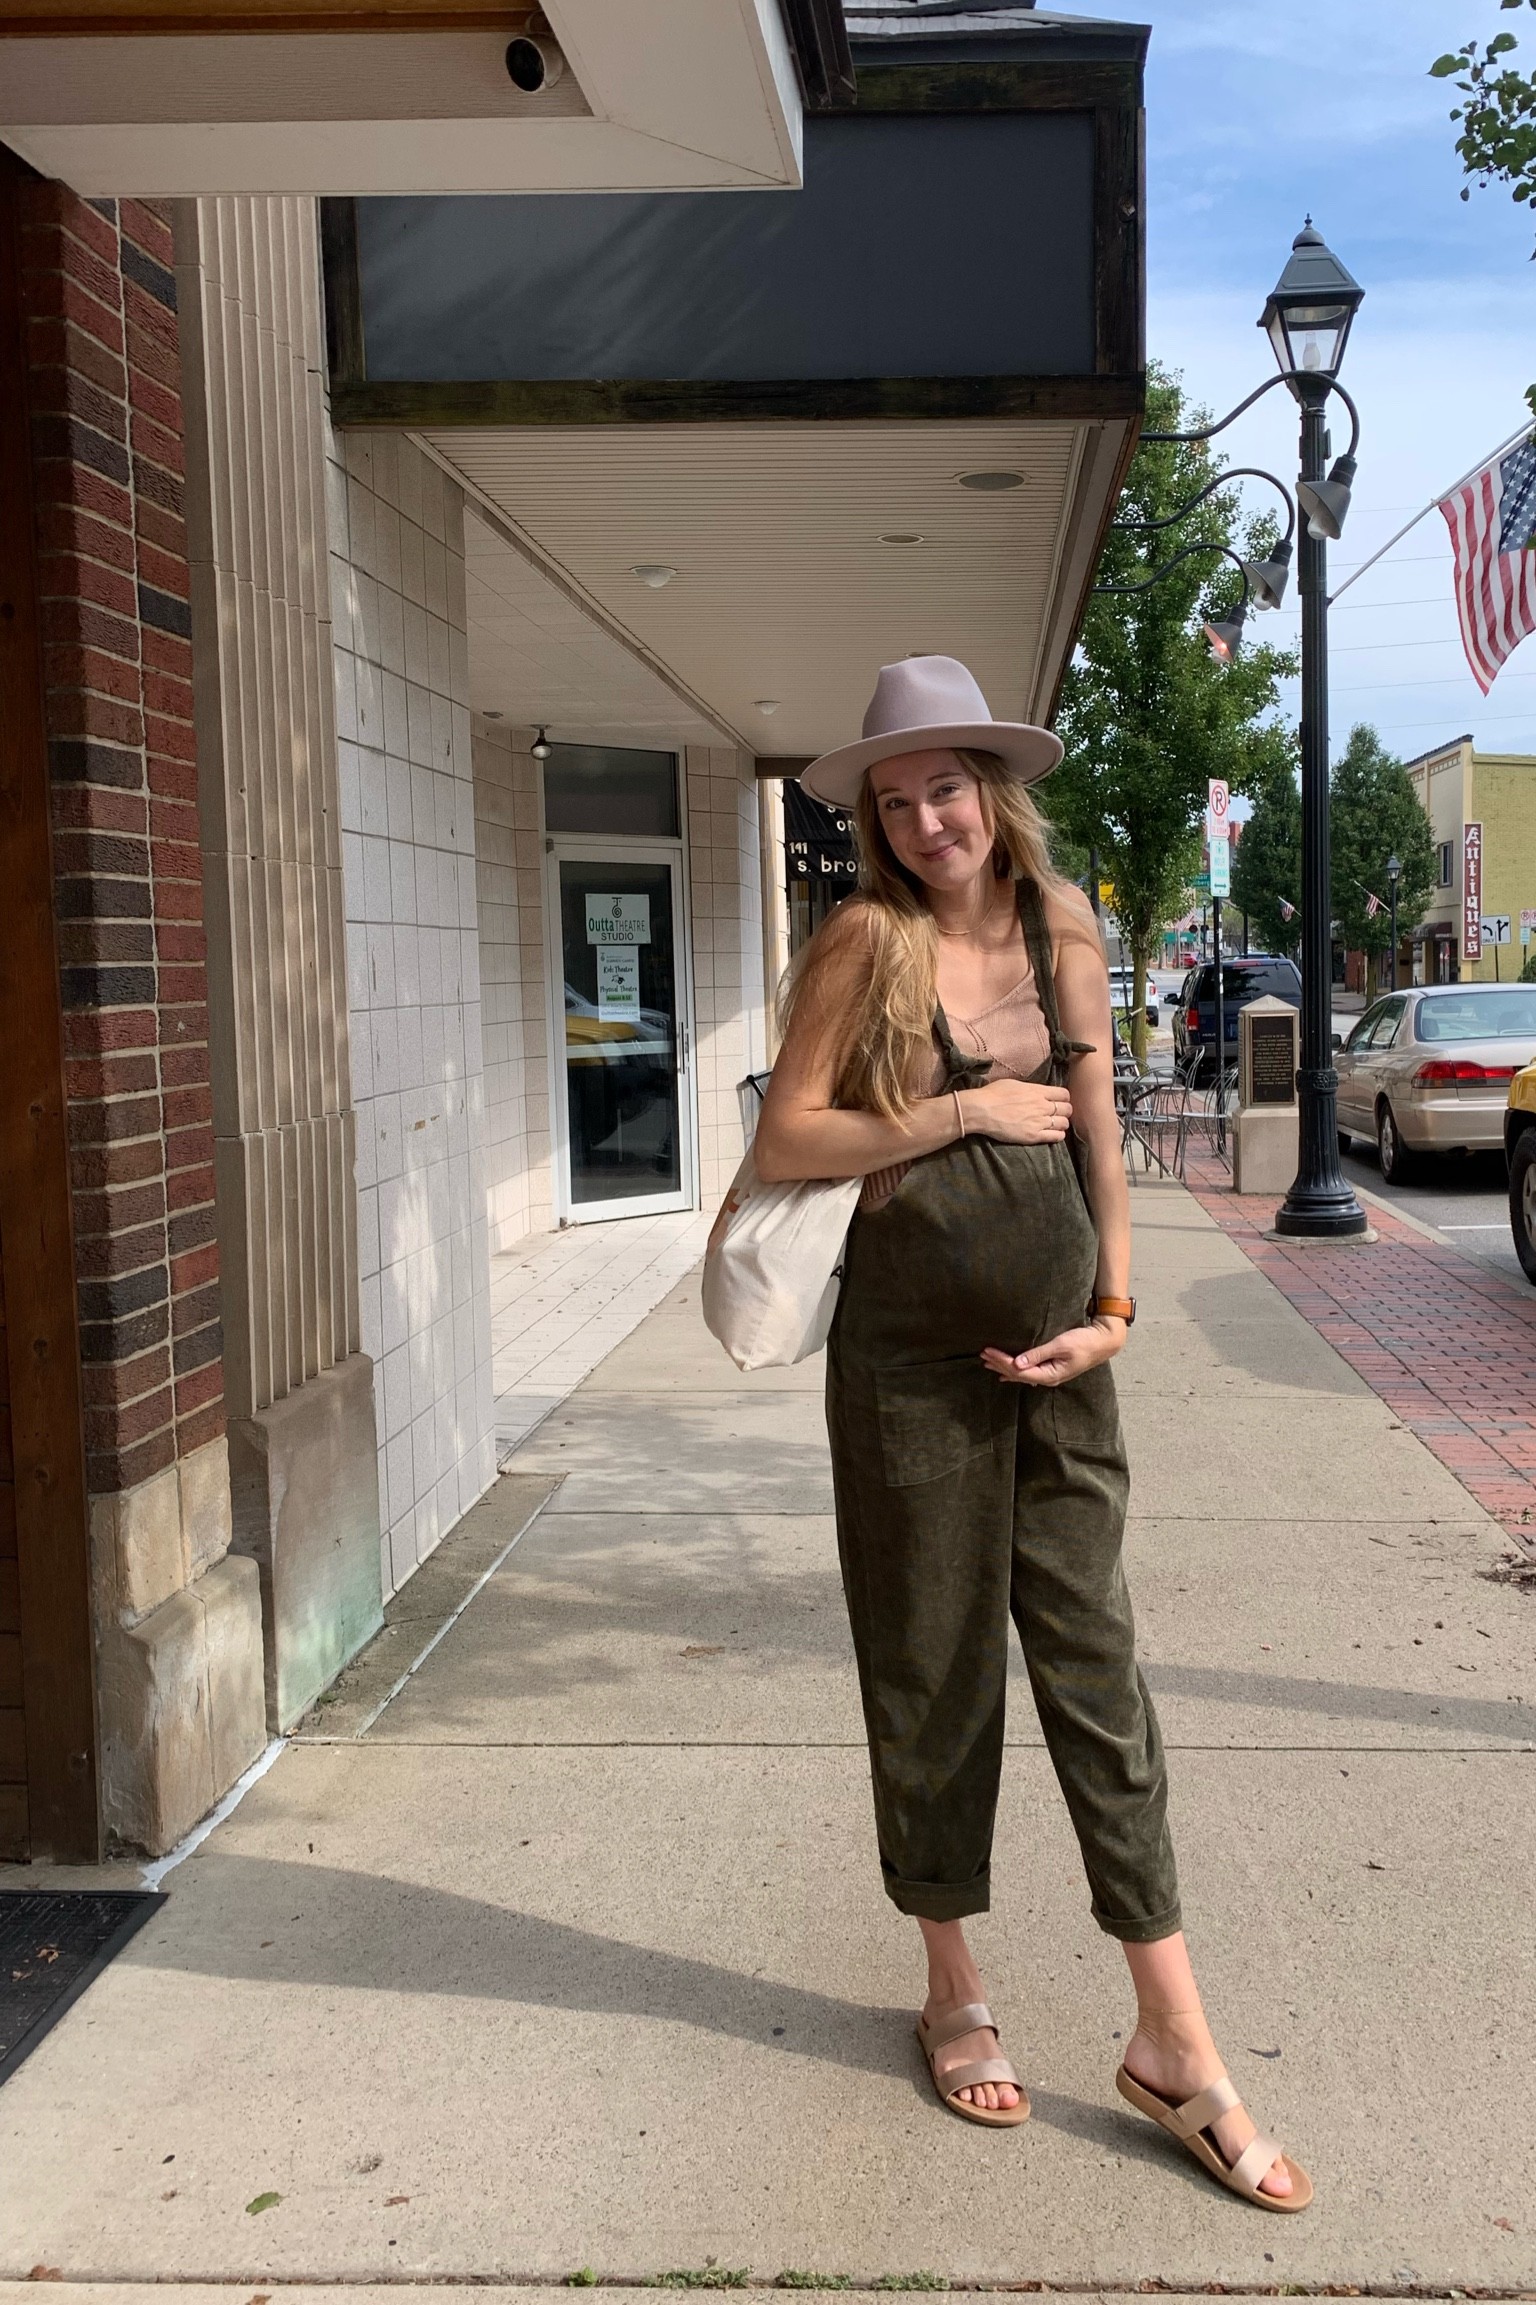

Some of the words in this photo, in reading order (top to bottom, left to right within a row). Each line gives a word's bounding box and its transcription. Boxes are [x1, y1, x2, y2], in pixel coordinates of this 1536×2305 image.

[1465, 826, 1481, 954] Antiques
[588, 918, 615, 932] Outta
[615, 919, 646, 932] THEATRE
[601, 932, 634, 941] STUDIO
